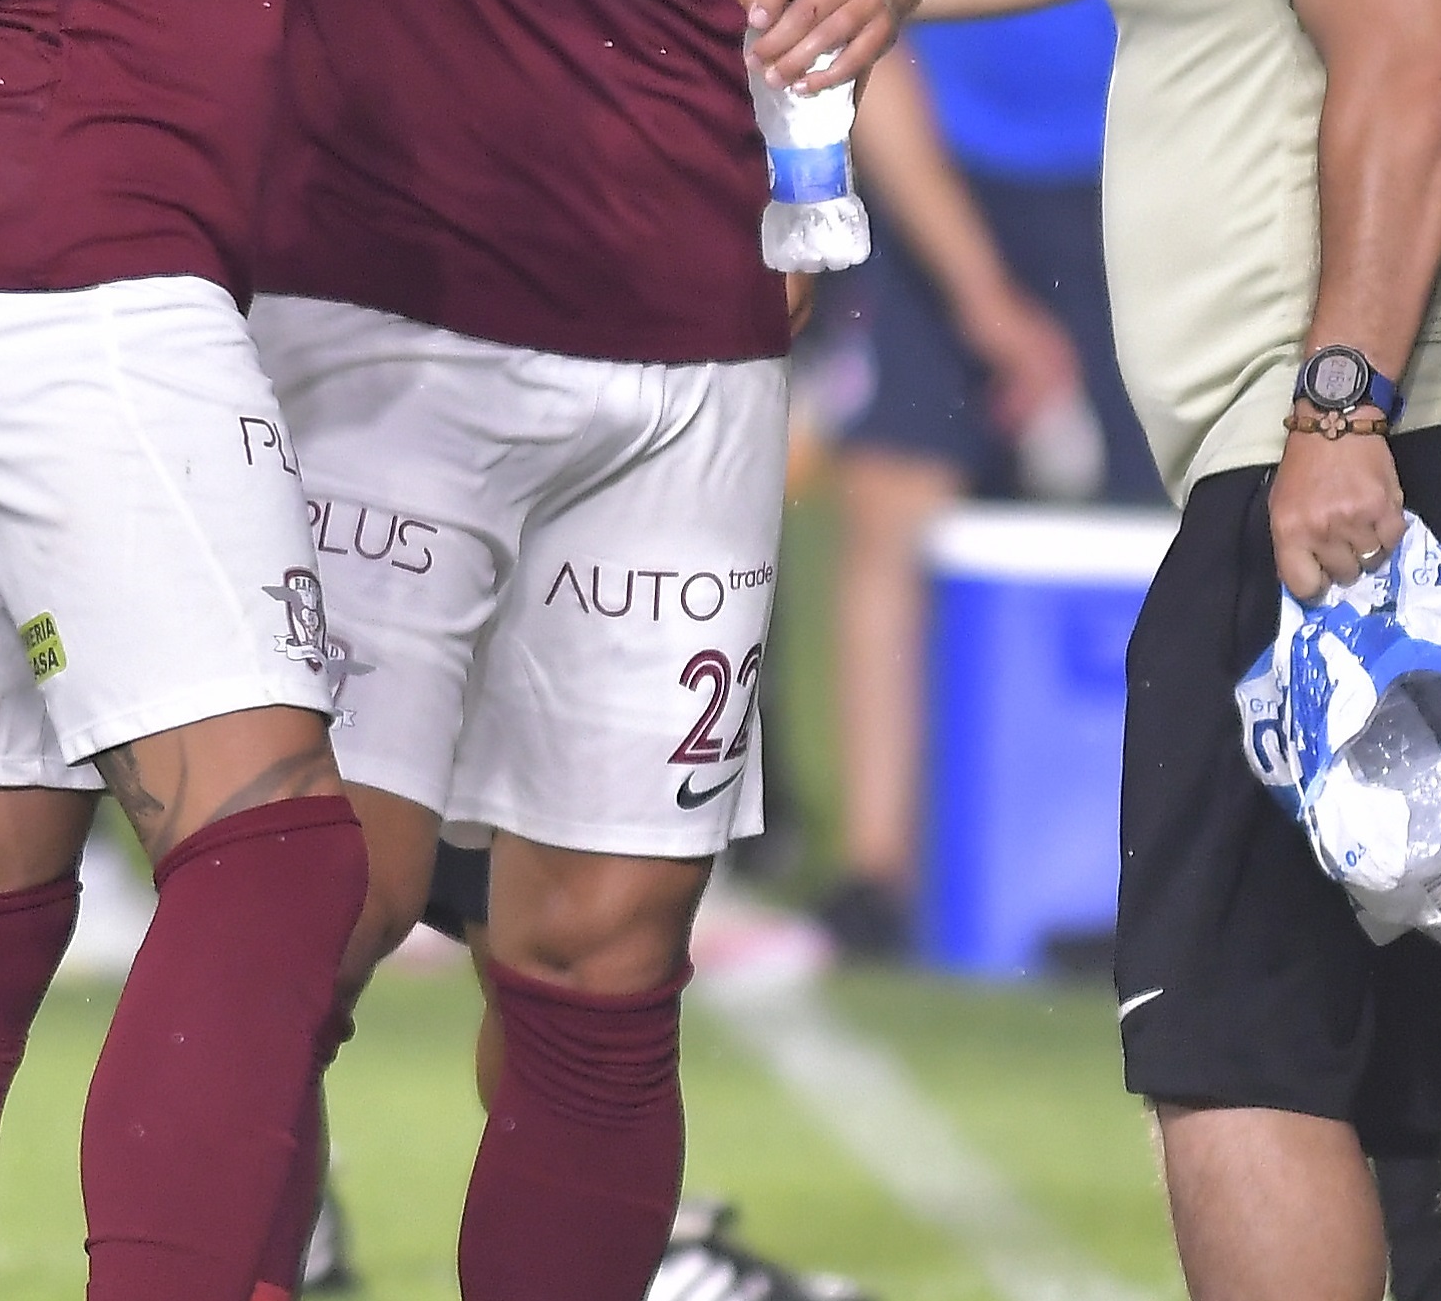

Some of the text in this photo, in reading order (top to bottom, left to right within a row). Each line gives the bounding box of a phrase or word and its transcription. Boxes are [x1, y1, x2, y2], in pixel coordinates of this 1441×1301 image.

[544, 561, 773, 622] AUTO trade
[666, 642, 764, 765] 22
